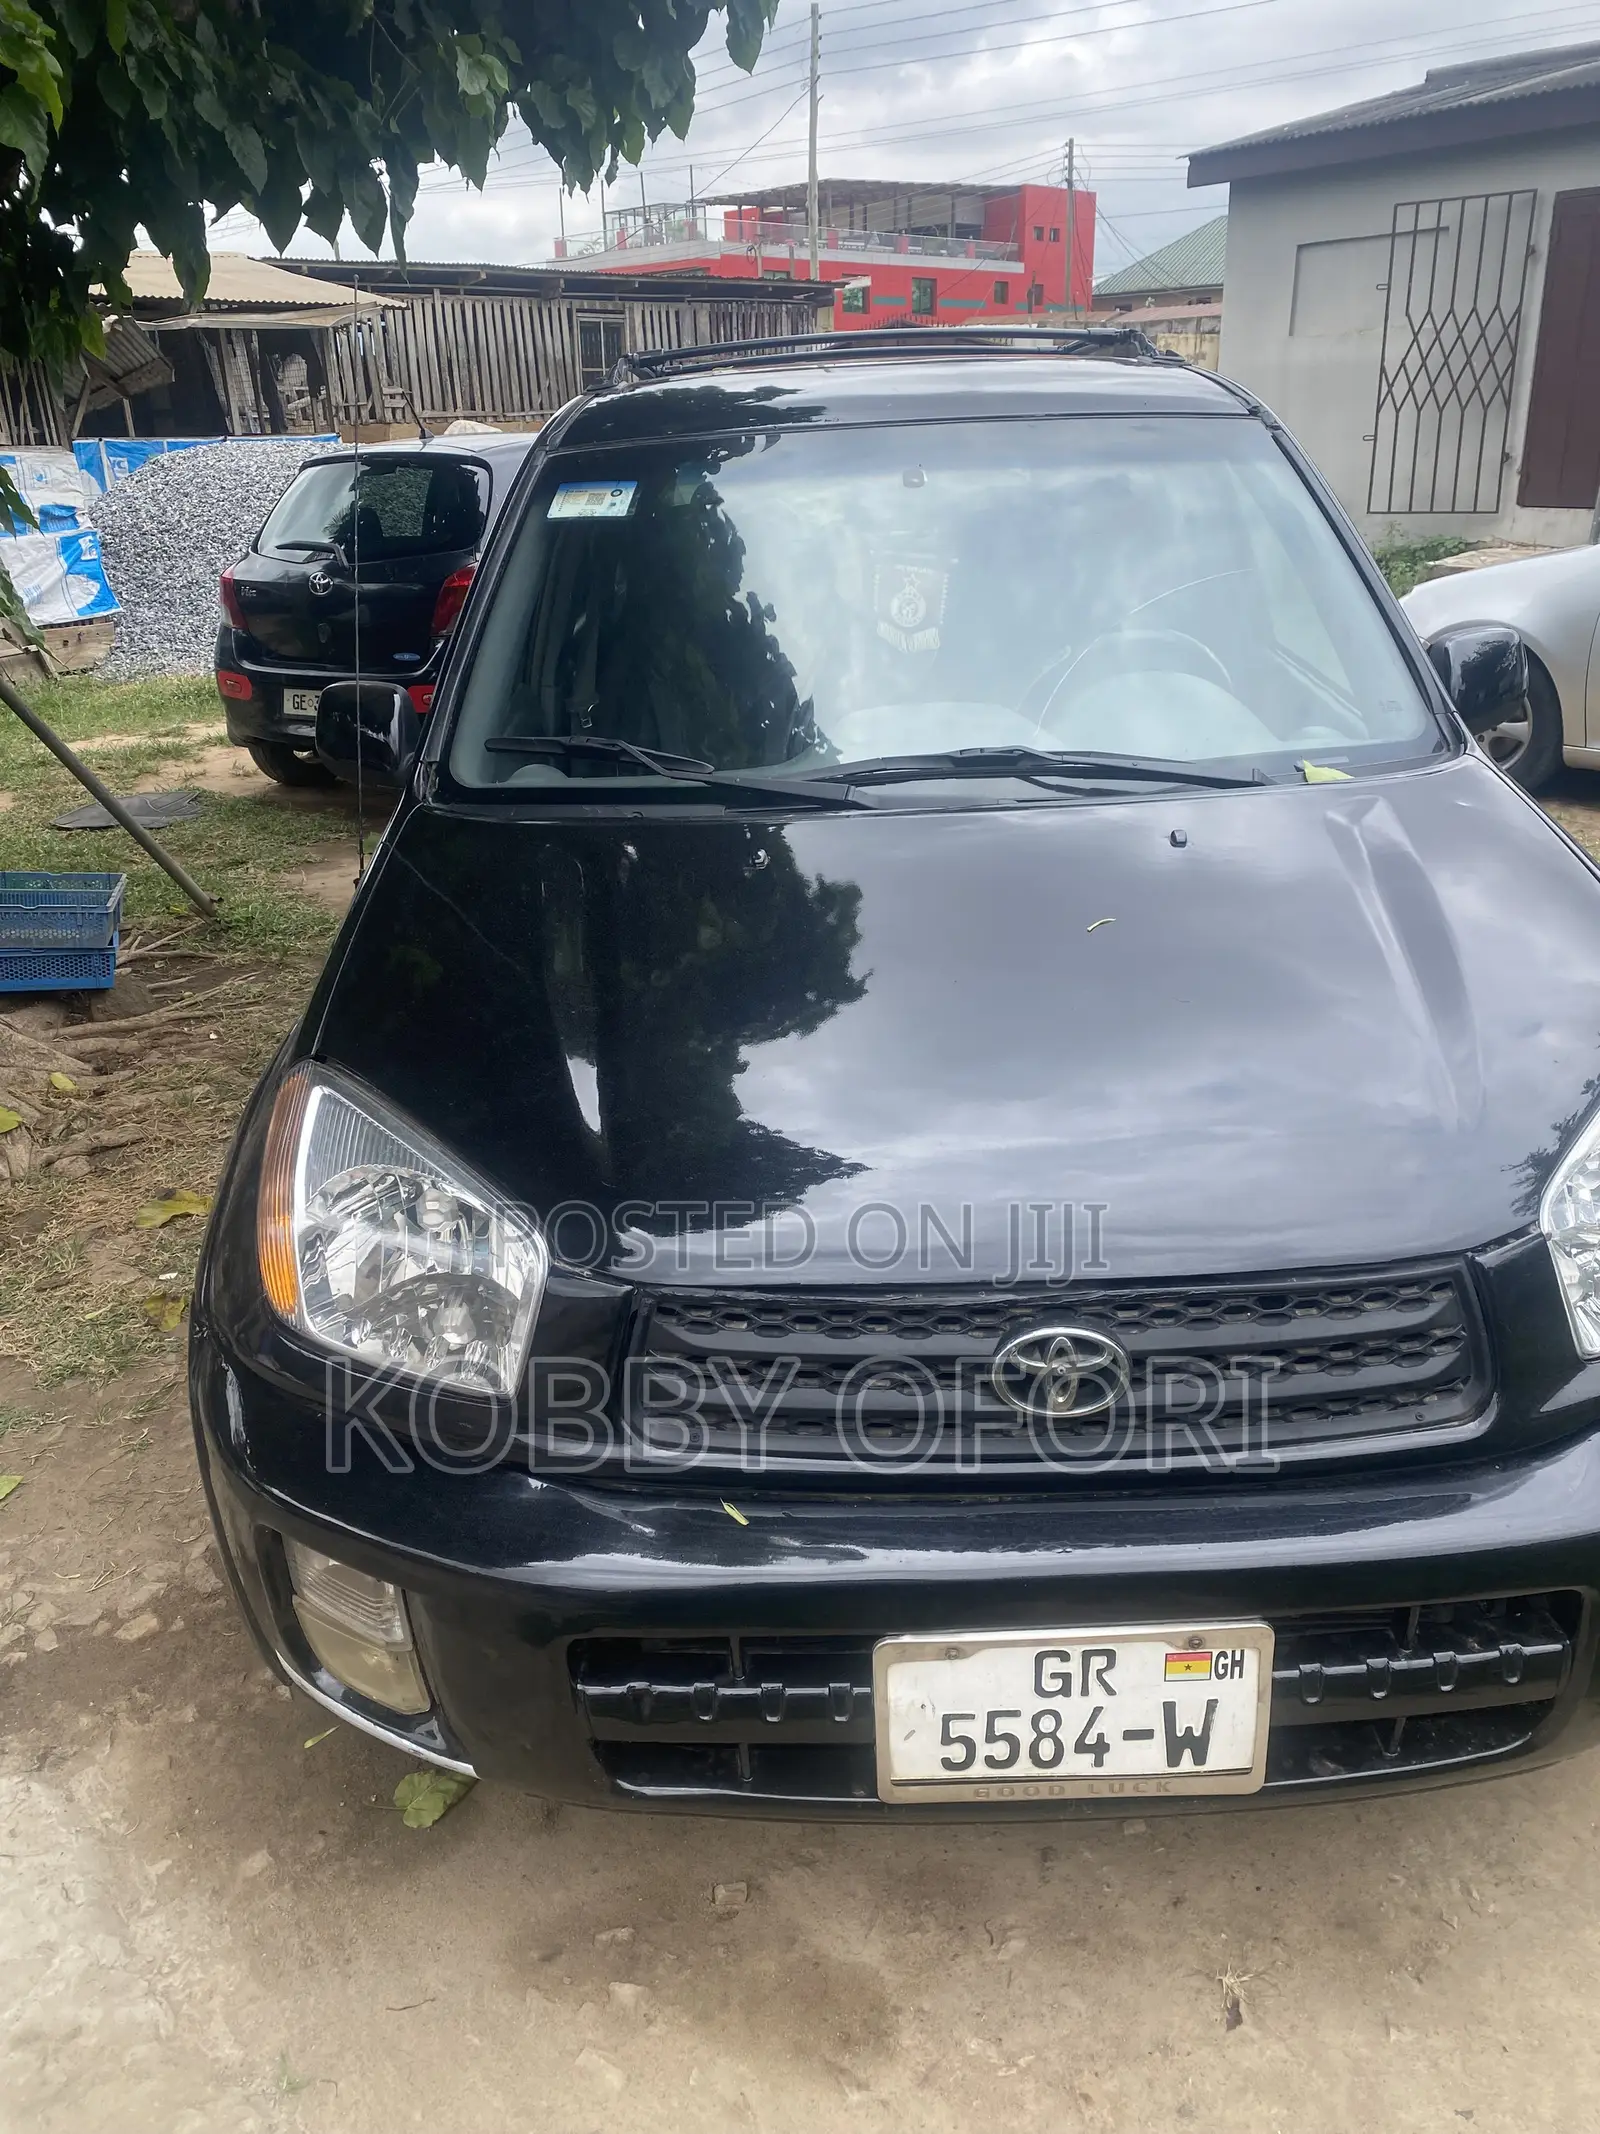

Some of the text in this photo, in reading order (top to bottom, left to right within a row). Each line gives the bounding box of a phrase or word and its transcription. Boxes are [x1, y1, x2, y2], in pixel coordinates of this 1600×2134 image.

[1034, 1649, 1117, 1698] GR
[1214, 1649, 1244, 1680] GH
[941, 1699, 1218, 1771] 5584-W
[973, 1781, 1172, 1799] GOOD LUCK
